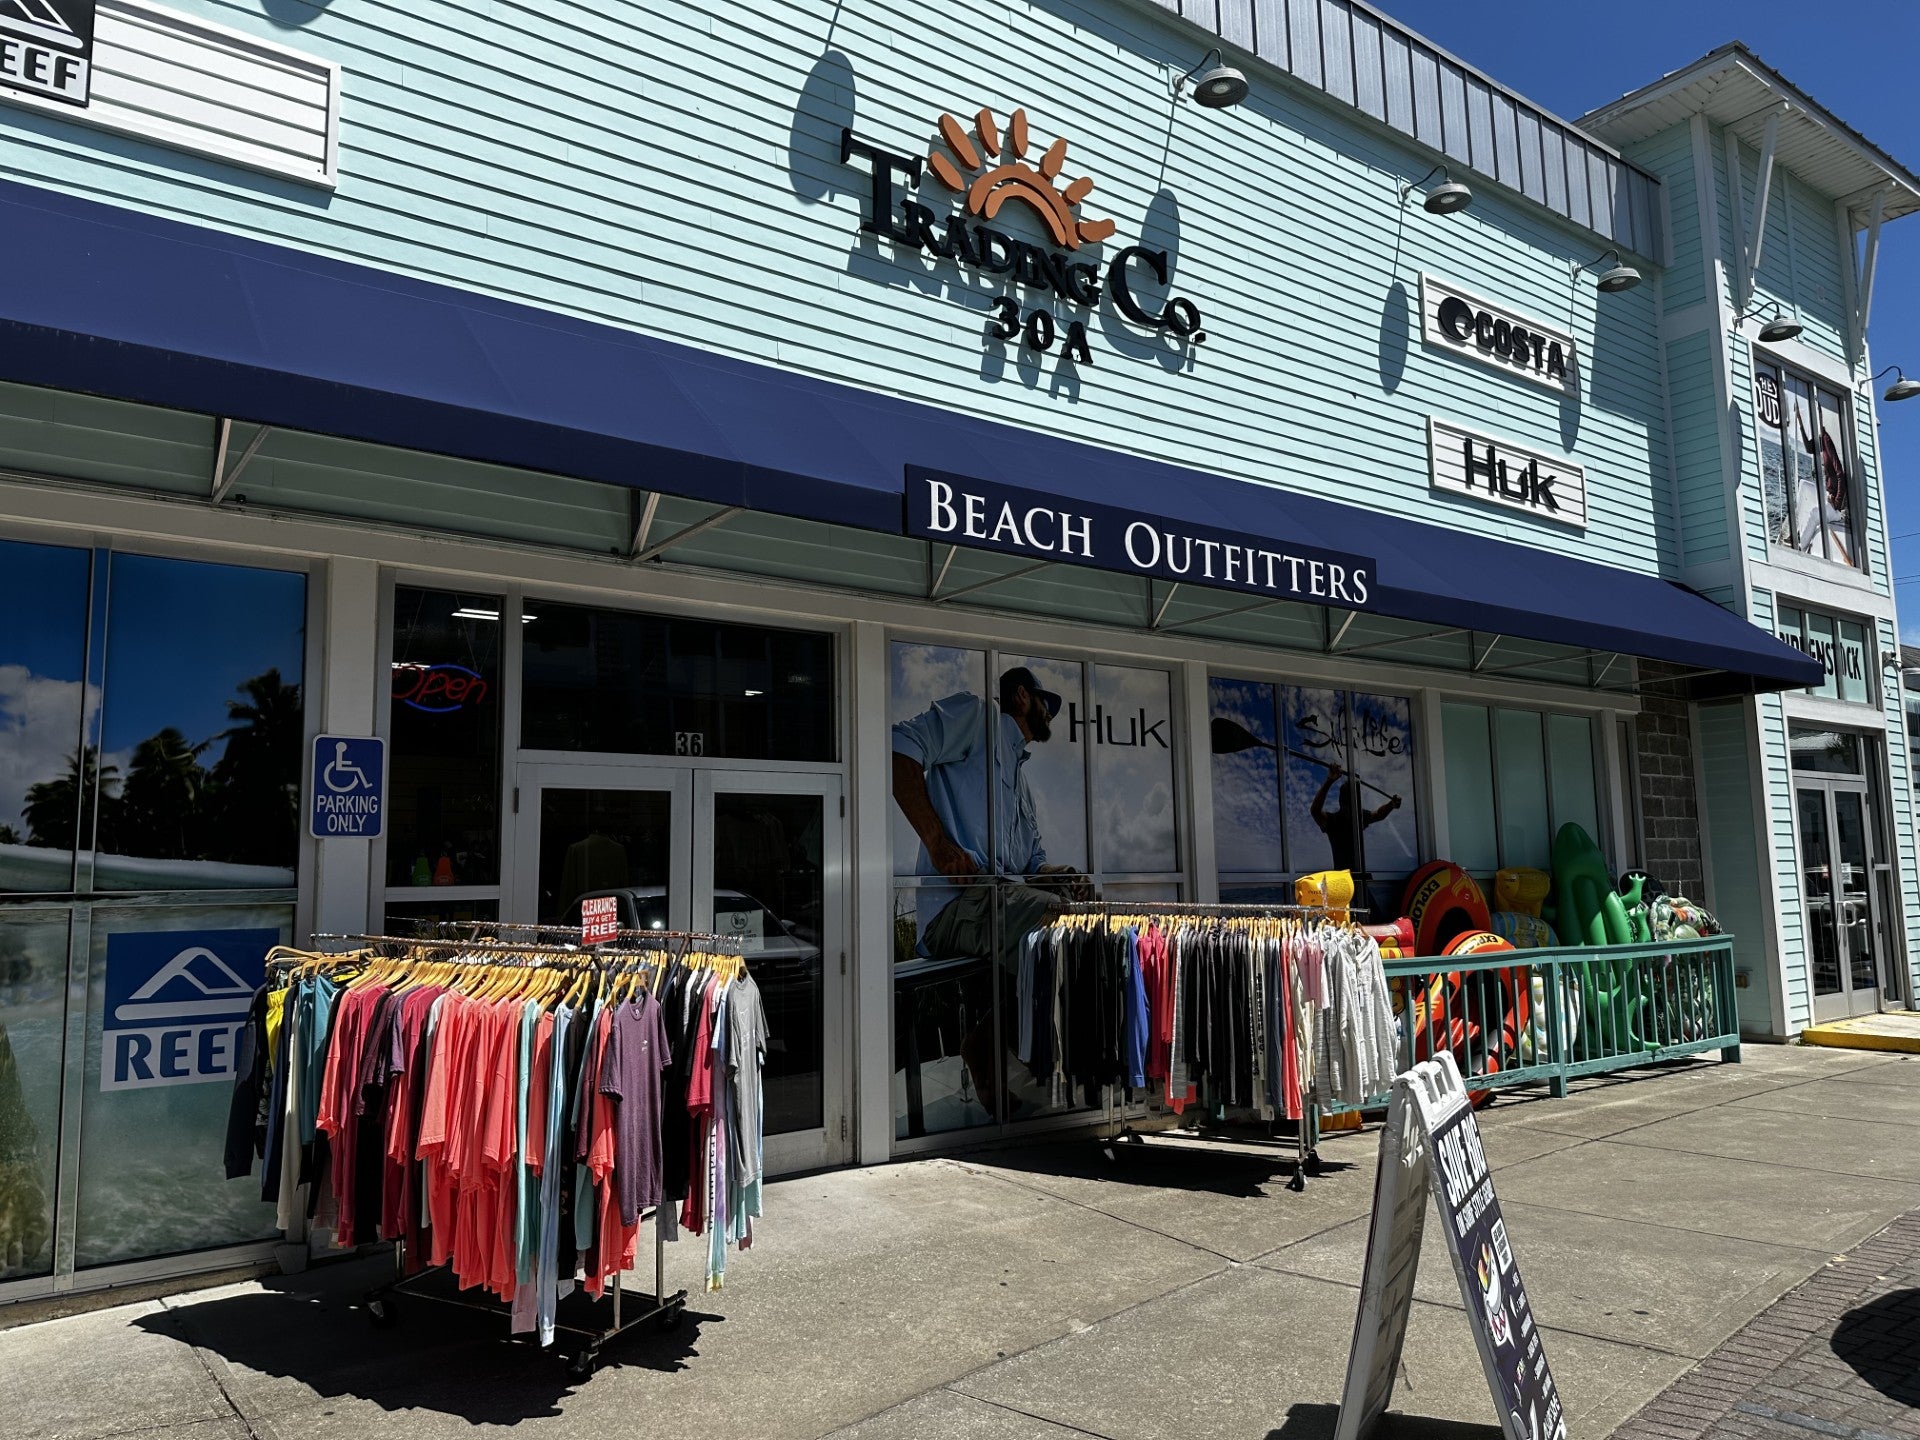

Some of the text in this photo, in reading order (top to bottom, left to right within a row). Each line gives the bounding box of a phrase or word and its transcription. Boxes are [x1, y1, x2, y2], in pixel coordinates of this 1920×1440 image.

[0, 38, 80, 90] EEF
[840, 128, 1102, 307] TRADING
[992, 296, 1093, 364] 30A
[1475, 309, 1567, 378] COSTA
[925, 479, 1369, 605] BEACH OUTFITTERS
[391, 665, 487, 703] Open
[676, 732, 703, 756] 36
[316, 795, 378, 814] PARKING
[327, 814, 367, 832] ONLY
[582, 897, 617, 916] CLEARANCE
[582, 921, 617, 937] FREE
[1438, 1112, 1488, 1207] SAVE BIG
